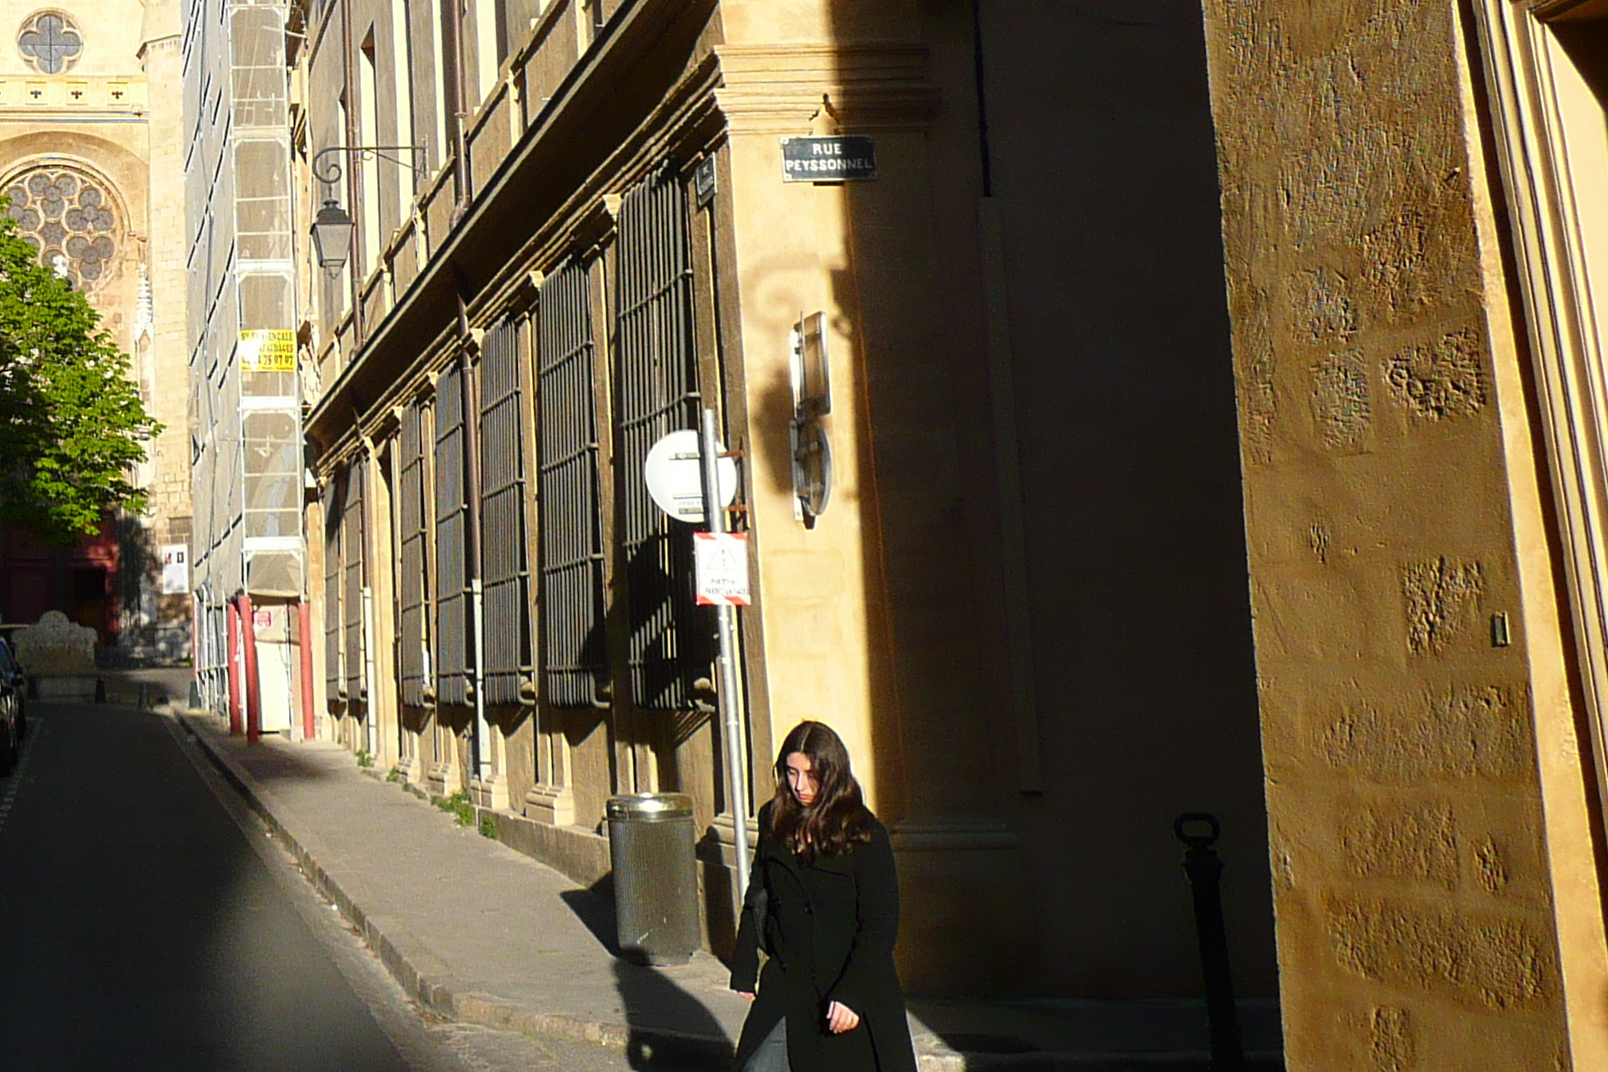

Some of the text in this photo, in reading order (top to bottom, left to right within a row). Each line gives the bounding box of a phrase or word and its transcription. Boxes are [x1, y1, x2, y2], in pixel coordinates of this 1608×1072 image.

[812, 143, 843, 155] RUE
[785, 158, 873, 171] PEYSSONNEL
[263, 354, 272, 365] 75
[274, 354, 283, 365] 07
[285, 354, 294, 366] 07
